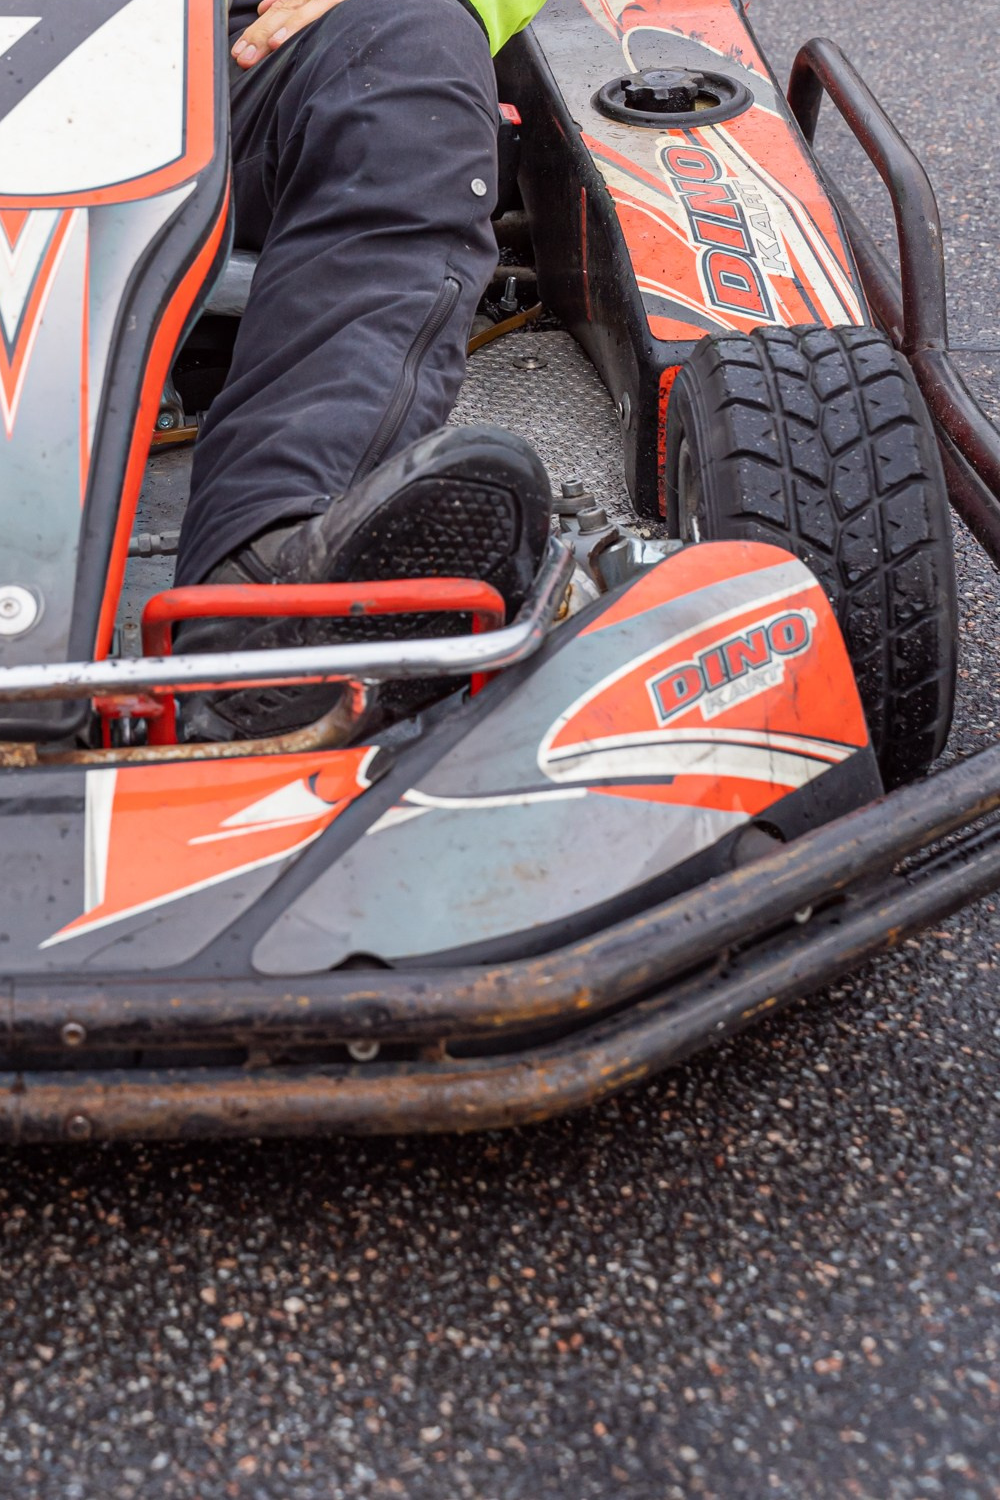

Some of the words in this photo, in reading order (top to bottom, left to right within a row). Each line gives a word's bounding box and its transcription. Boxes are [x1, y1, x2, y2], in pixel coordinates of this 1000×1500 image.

[660, 145, 777, 322] DINO
[731, 179, 787, 272] KART
[651, 612, 811, 721] DINO
[705, 663, 782, 715] KART
